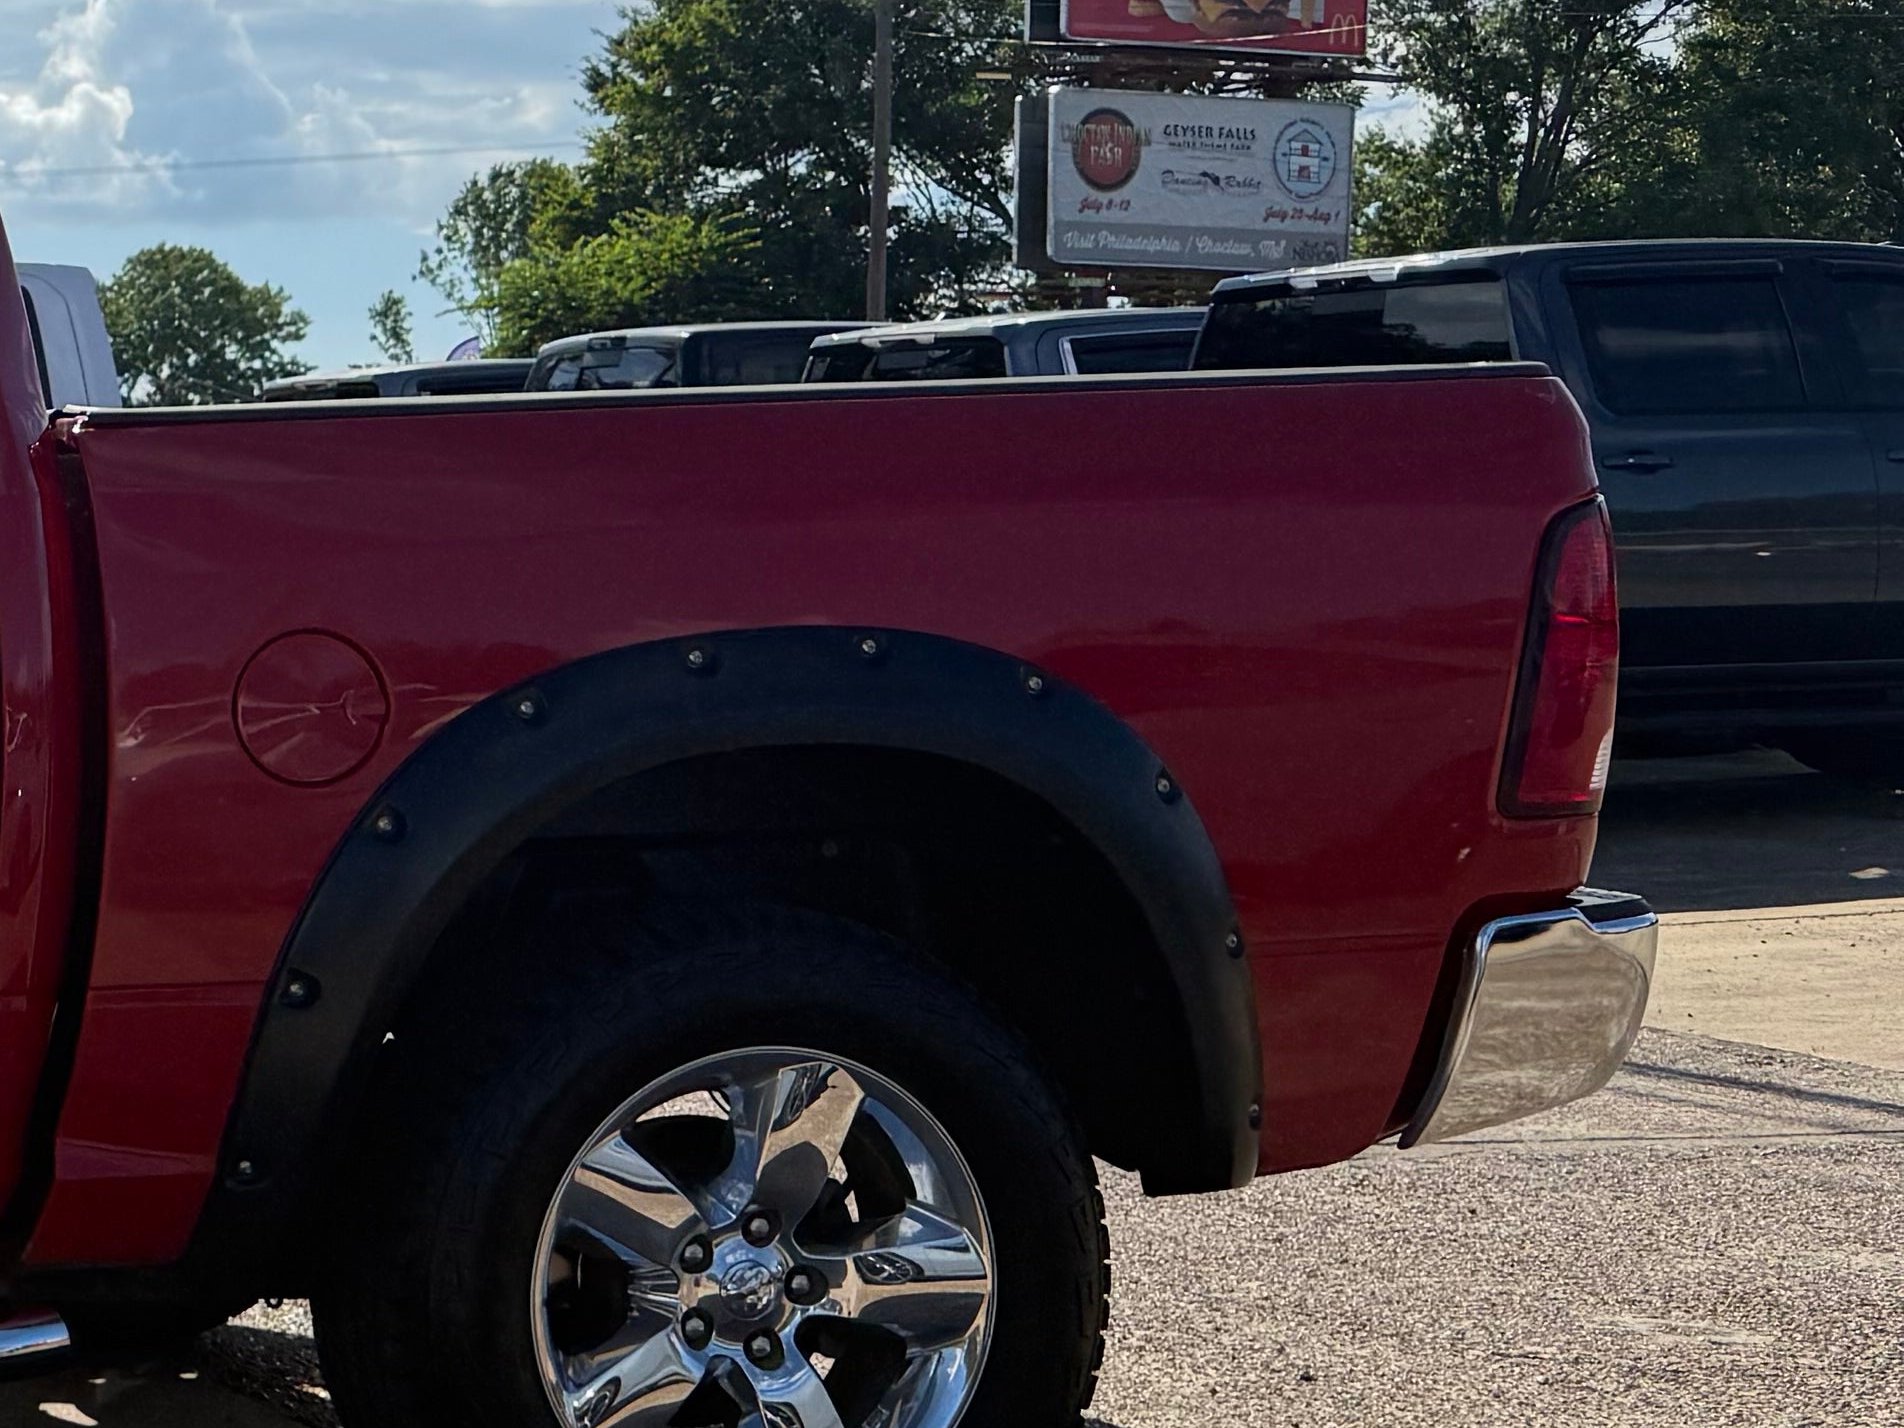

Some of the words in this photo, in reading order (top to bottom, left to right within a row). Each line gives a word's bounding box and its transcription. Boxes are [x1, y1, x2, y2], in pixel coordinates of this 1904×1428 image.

[1163, 124, 1213, 139] GEYSER
[1218, 126, 1256, 141] FALLS
[1078, 196, 1103, 214] July
[1263, 206, 1289, 223] July
[1063, 230, 1095, 249] Visit
[1097, 230, 1182, 254] Philadelphia
